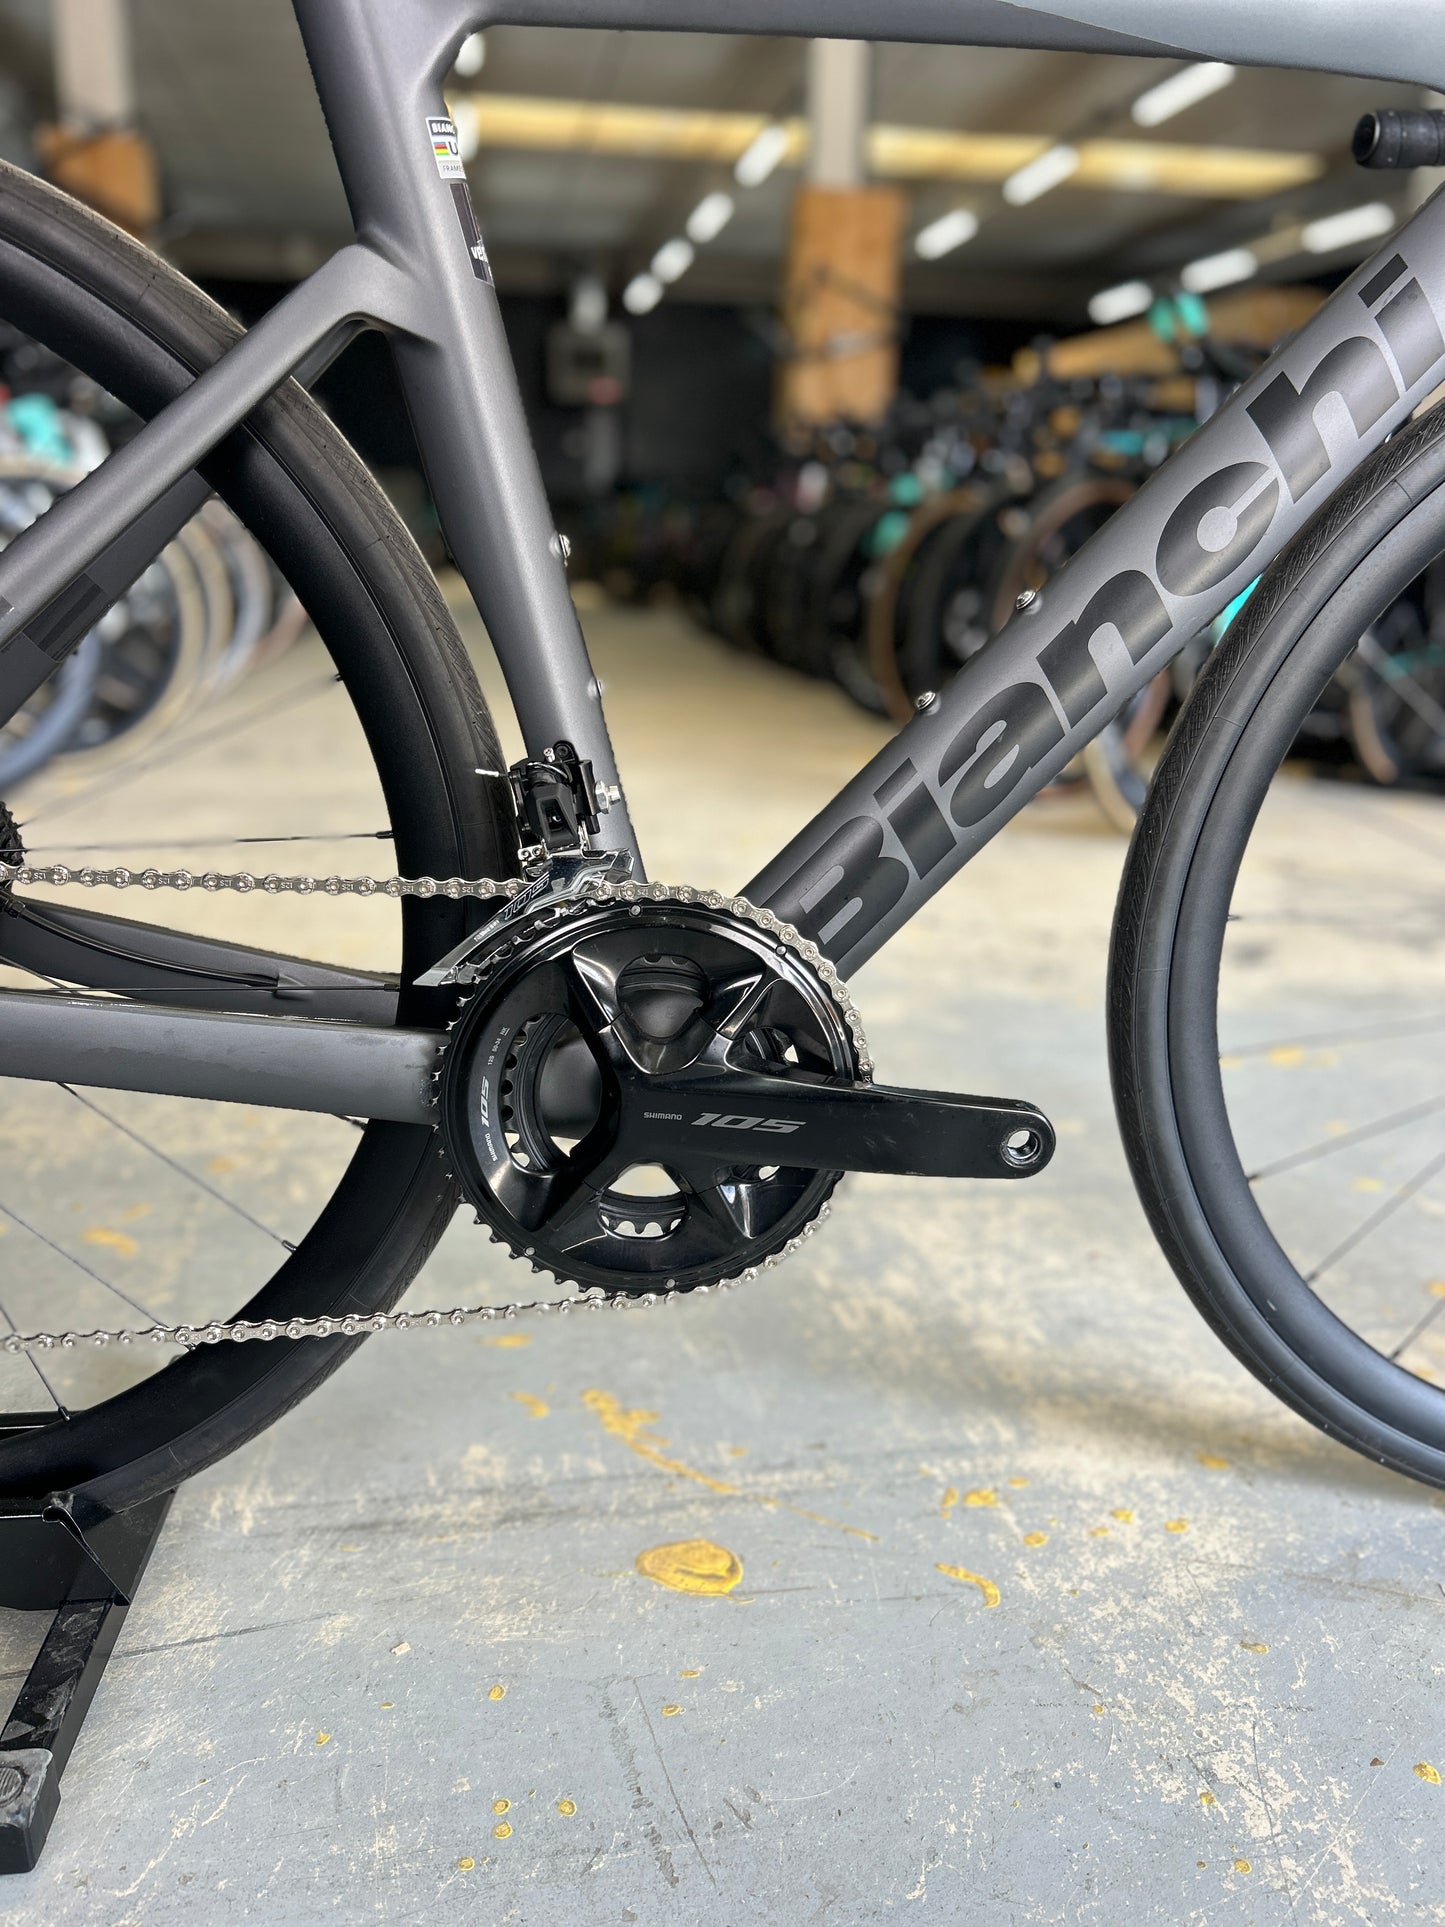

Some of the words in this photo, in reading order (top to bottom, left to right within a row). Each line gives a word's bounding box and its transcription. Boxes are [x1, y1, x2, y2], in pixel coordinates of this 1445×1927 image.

[759, 253, 1445, 965] Bianchi
[480, 1076, 490, 1128] 105
[643, 1111, 683, 1121] SHIMANO
[690, 1112, 807, 1134] 105
